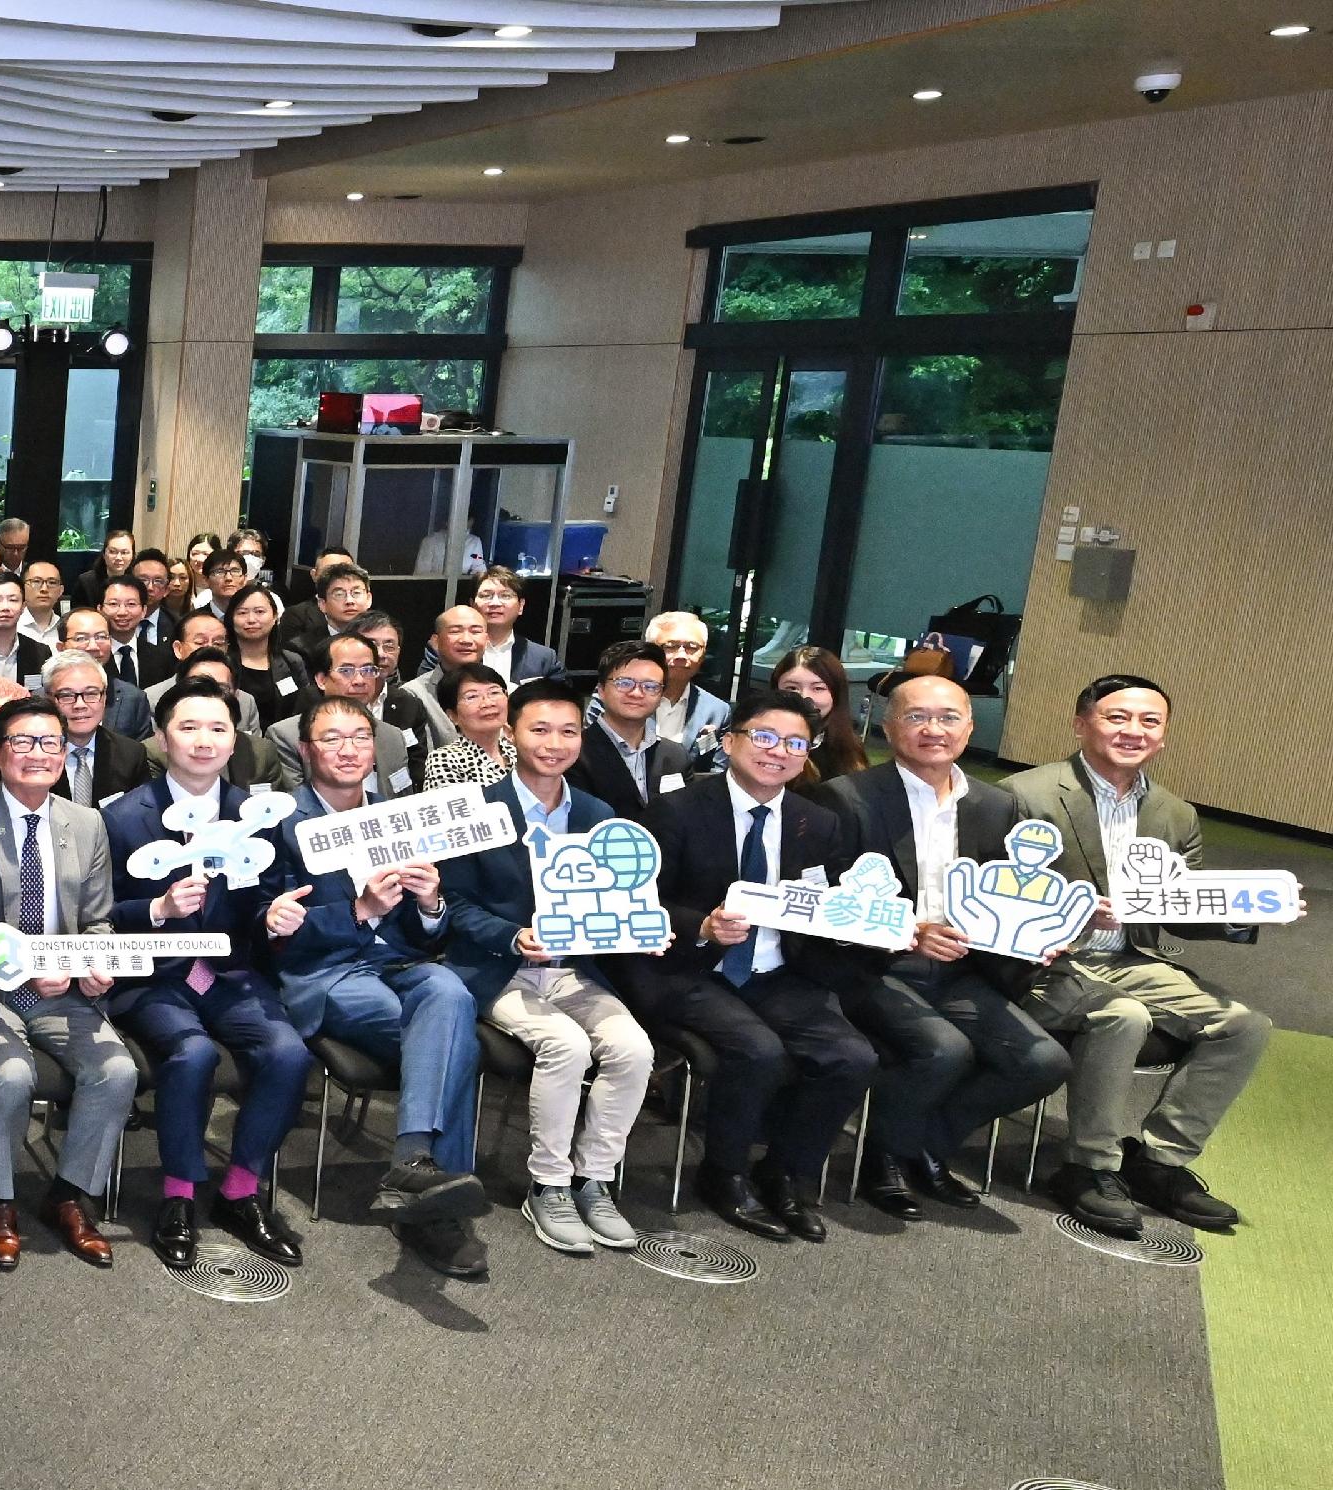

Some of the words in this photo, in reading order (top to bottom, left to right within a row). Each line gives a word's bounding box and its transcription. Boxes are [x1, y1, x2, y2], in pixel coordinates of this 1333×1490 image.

[43, 295, 67, 319] EXIT
[70, 295, 91, 319] 出口
[555, 862, 596, 884] 4S
[740, 884, 907, 937] 一齊參與
[1121, 887, 1282, 916] 支持用4S
[31, 941, 115, 951] CONSTRUCTION
[119, 940, 172, 951] INDUSTRY
[176, 939, 224, 950] COUNCIL
[32, 955, 144, 971] 建造業議會
